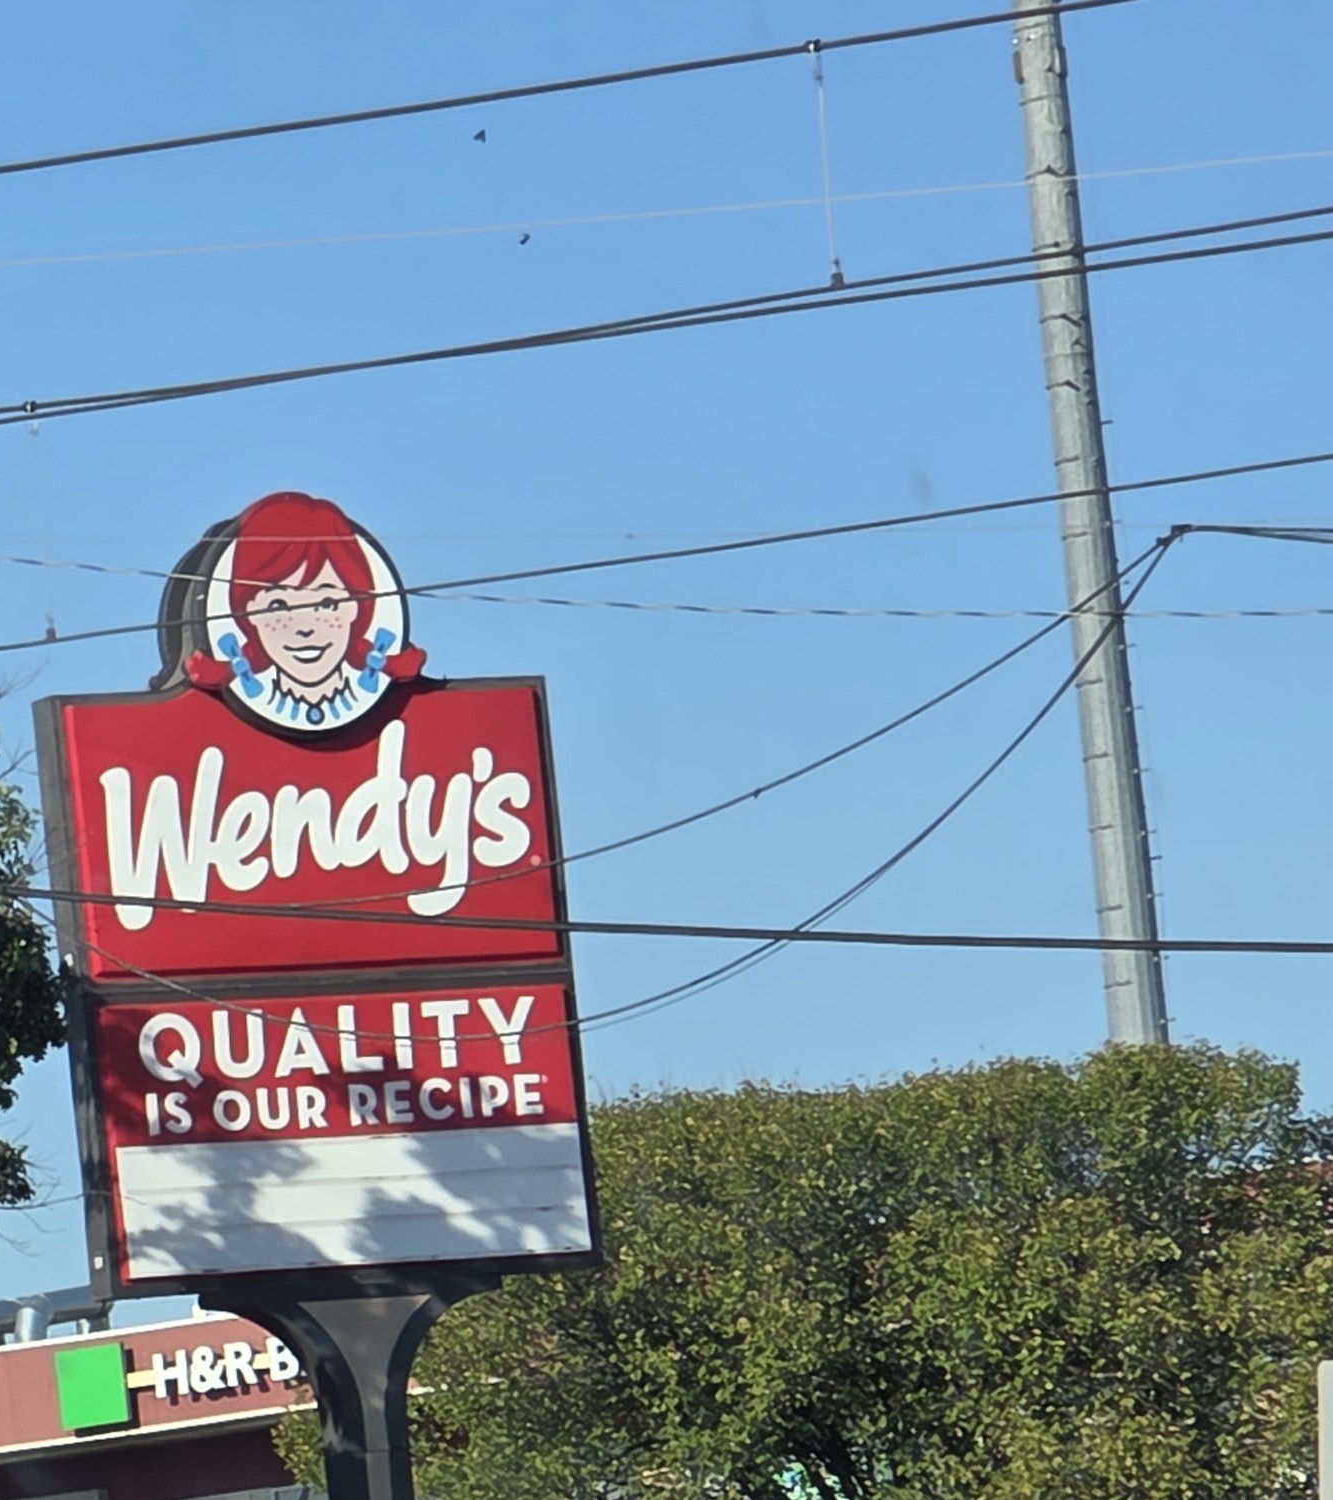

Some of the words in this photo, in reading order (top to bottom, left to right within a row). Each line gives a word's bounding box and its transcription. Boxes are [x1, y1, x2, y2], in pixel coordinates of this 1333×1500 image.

[99, 719, 531, 931] Wendy's
[139, 996, 534, 1089] QUALITY
[145, 1091, 193, 1136] IS
[213, 1085, 328, 1132] OUR
[348, 1074, 545, 1127] RECIPE
[152, 1341, 258, 1398] H&R
